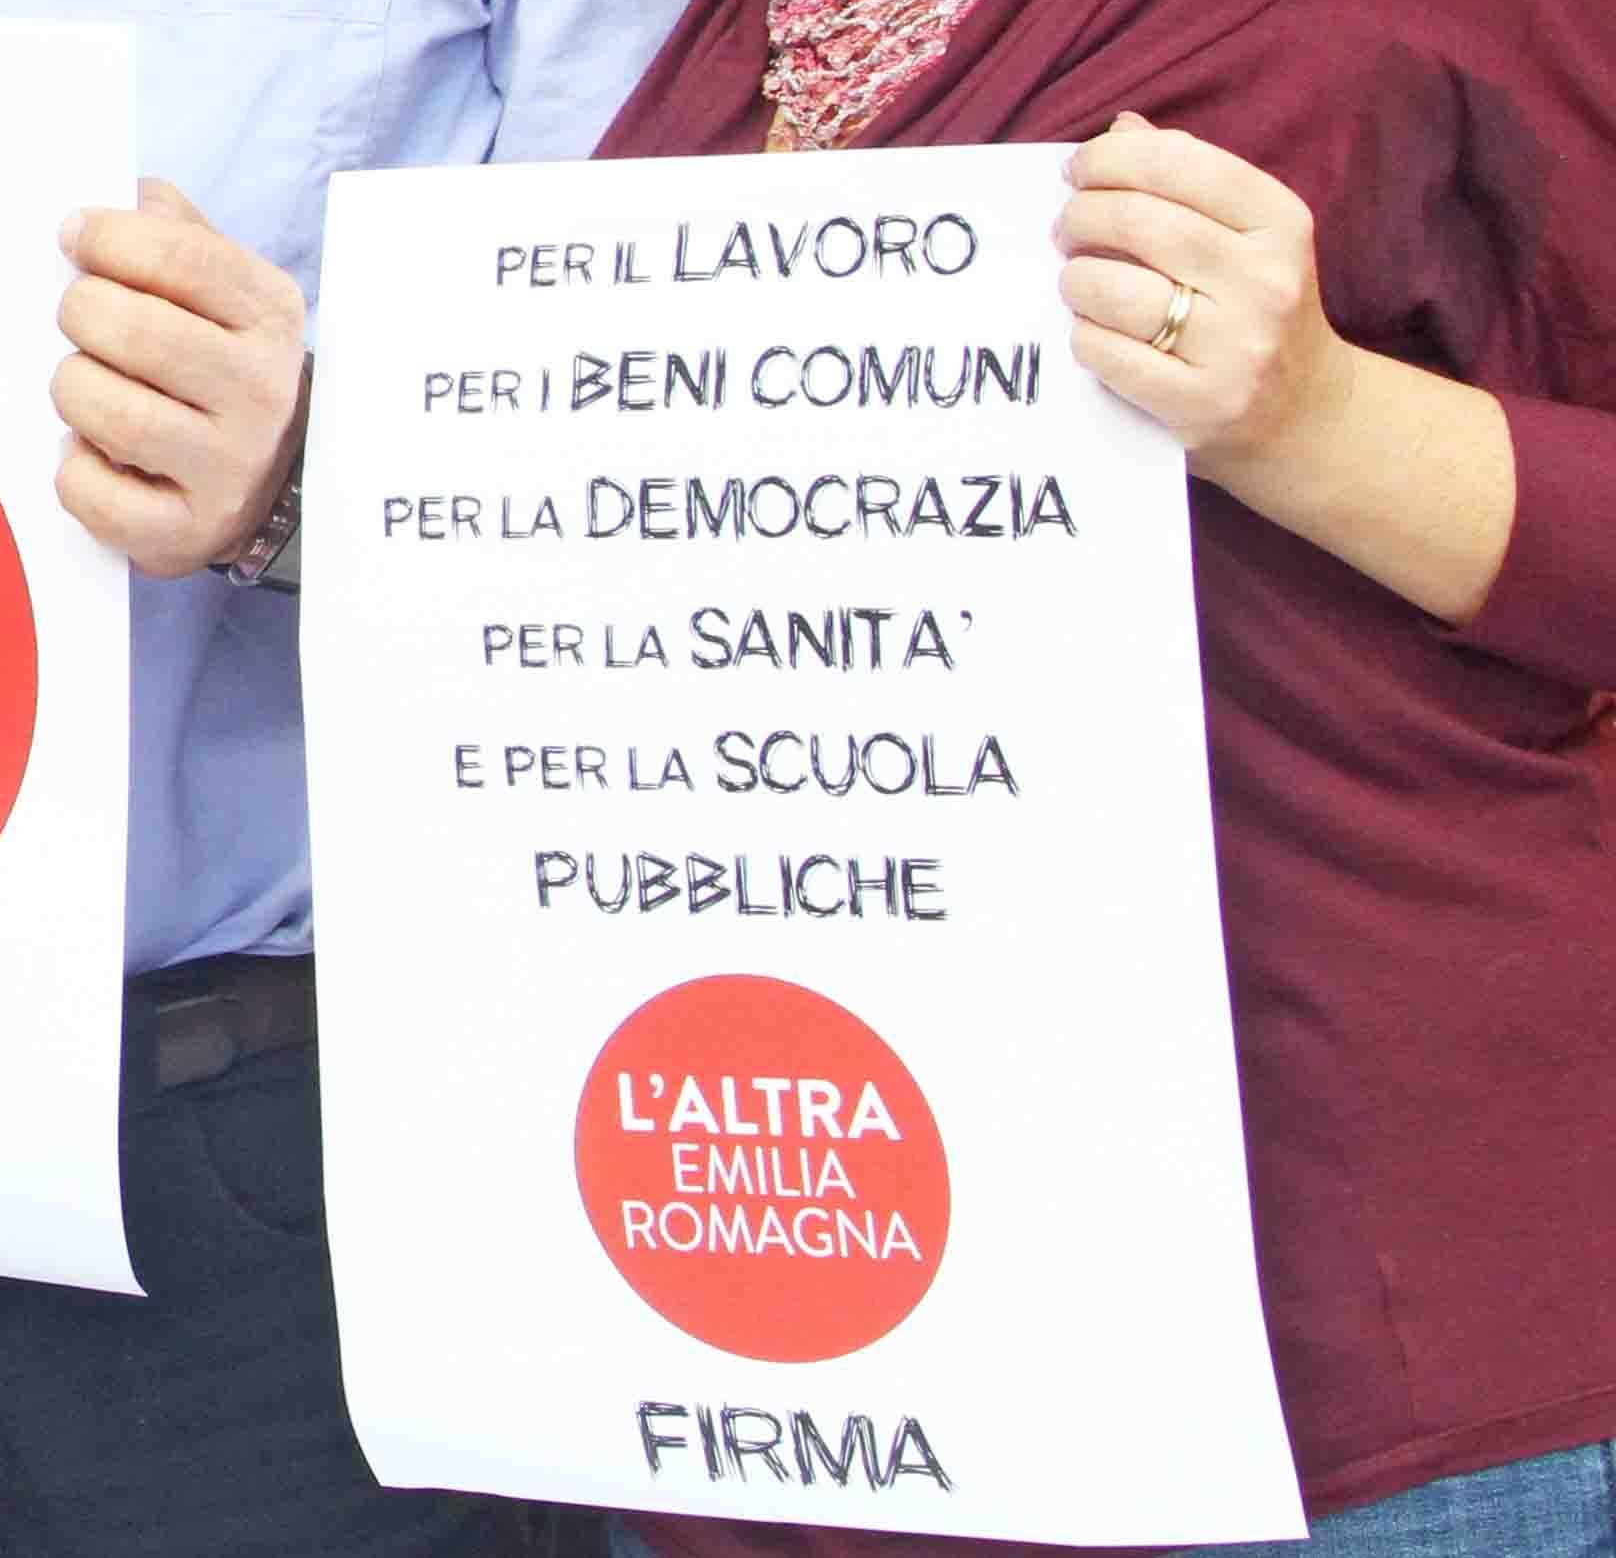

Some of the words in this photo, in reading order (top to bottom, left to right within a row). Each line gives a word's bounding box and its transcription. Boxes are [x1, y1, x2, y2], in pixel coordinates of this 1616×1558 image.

[497, 243, 594, 287] PER
[614, 242, 651, 285] IL
[673, 213, 978, 282] LAVORO
[425, 370, 521, 414] PER
[540, 370, 549, 412] I
[571, 350, 726, 411] BENI
[751, 343, 1040, 409] COMUNI
[384, 495, 481, 540] PER
[502, 496, 563, 539] LA
[584, 474, 1078, 541] DEMOCRAZIA
[483, 624, 584, 668] PER
[605, 626, 668, 668] LA
[456, 745, 484, 788] E
[504, 746, 608, 789] PER
[628, 748, 694, 791] LA
[715, 730, 1019, 797] SCUOLA
[535, 851, 948, 921] PUBBLICHE
[618, 1073, 900, 1140] L'ALTRA
[672, 1143, 856, 1198] EMILIA
[622, 1201, 920, 1259] ROMAGNA
[636, 1401, 952, 1492] FIRMA
